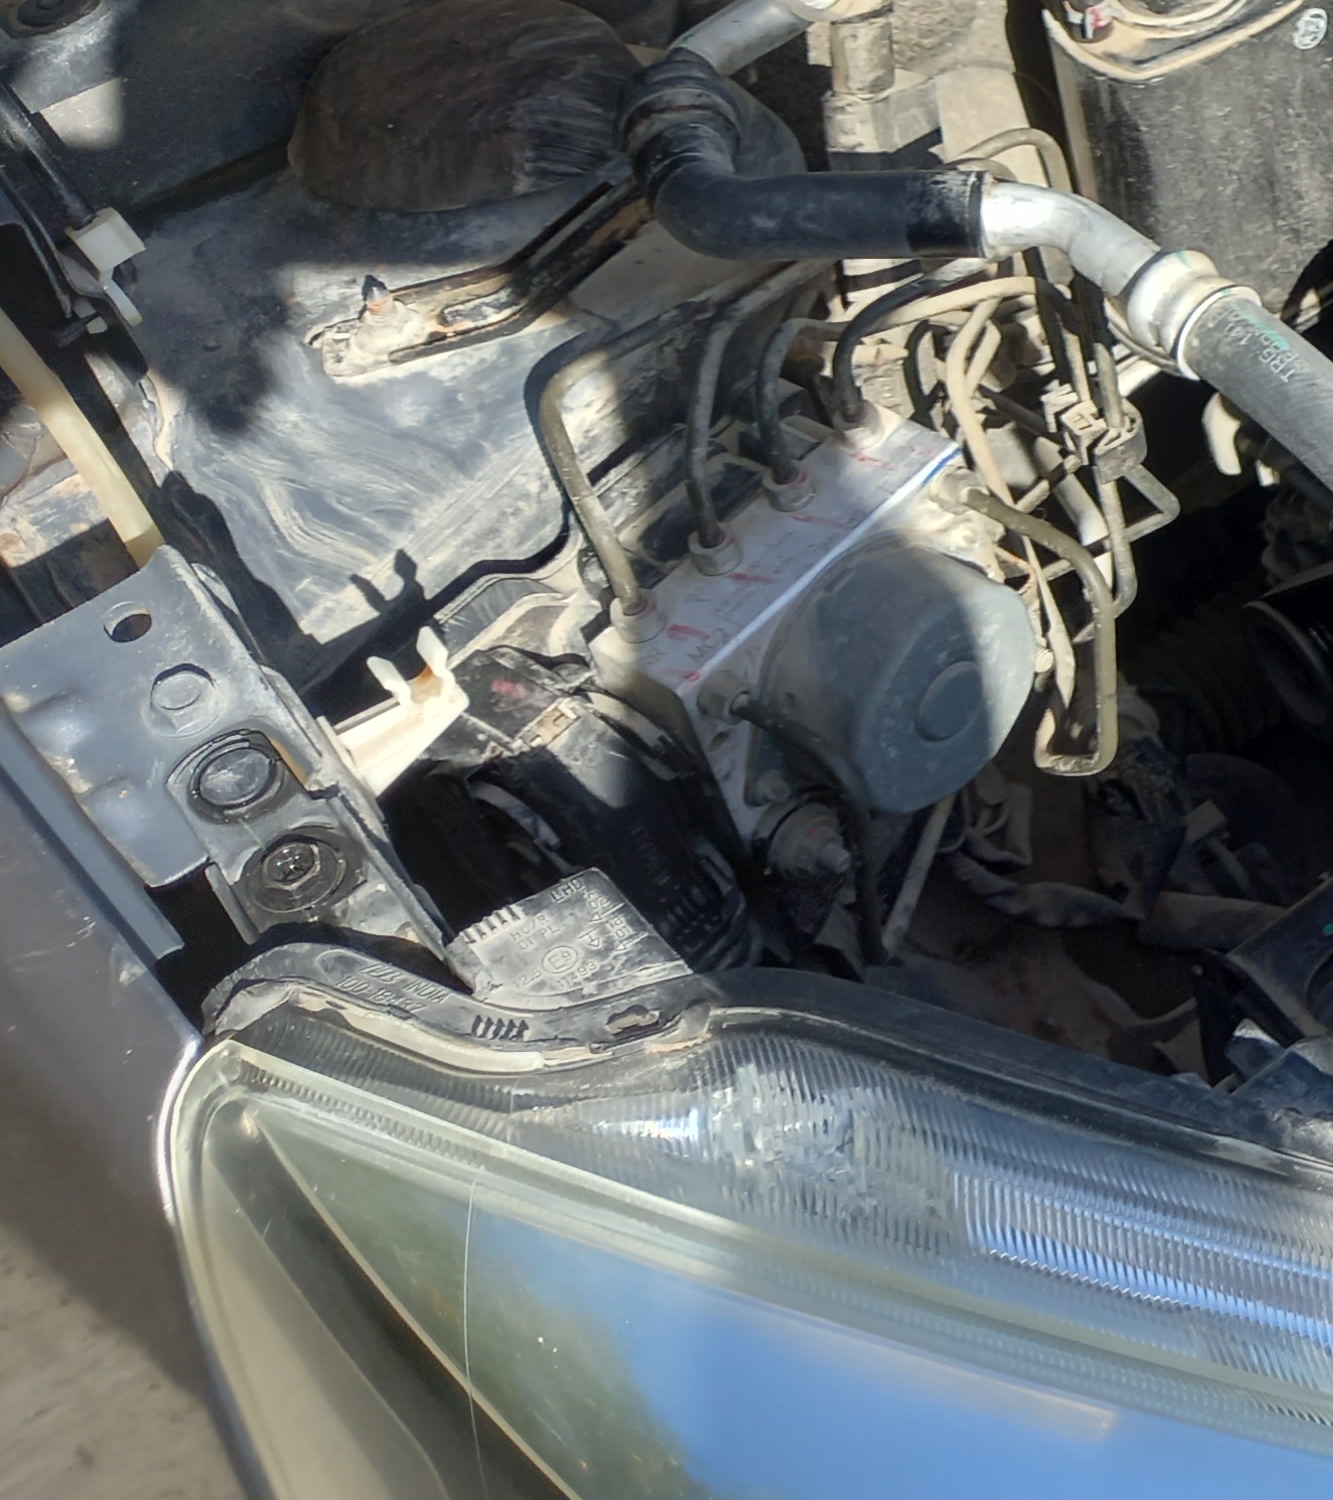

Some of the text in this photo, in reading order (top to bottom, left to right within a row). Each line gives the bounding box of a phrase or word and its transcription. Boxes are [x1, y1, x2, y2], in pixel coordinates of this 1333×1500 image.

[549, 876, 585, 902] LHD
[509, 913, 550, 941] HC/R
[537, 920, 561, 939] PL
[402, 978, 450, 1004] INDIA
